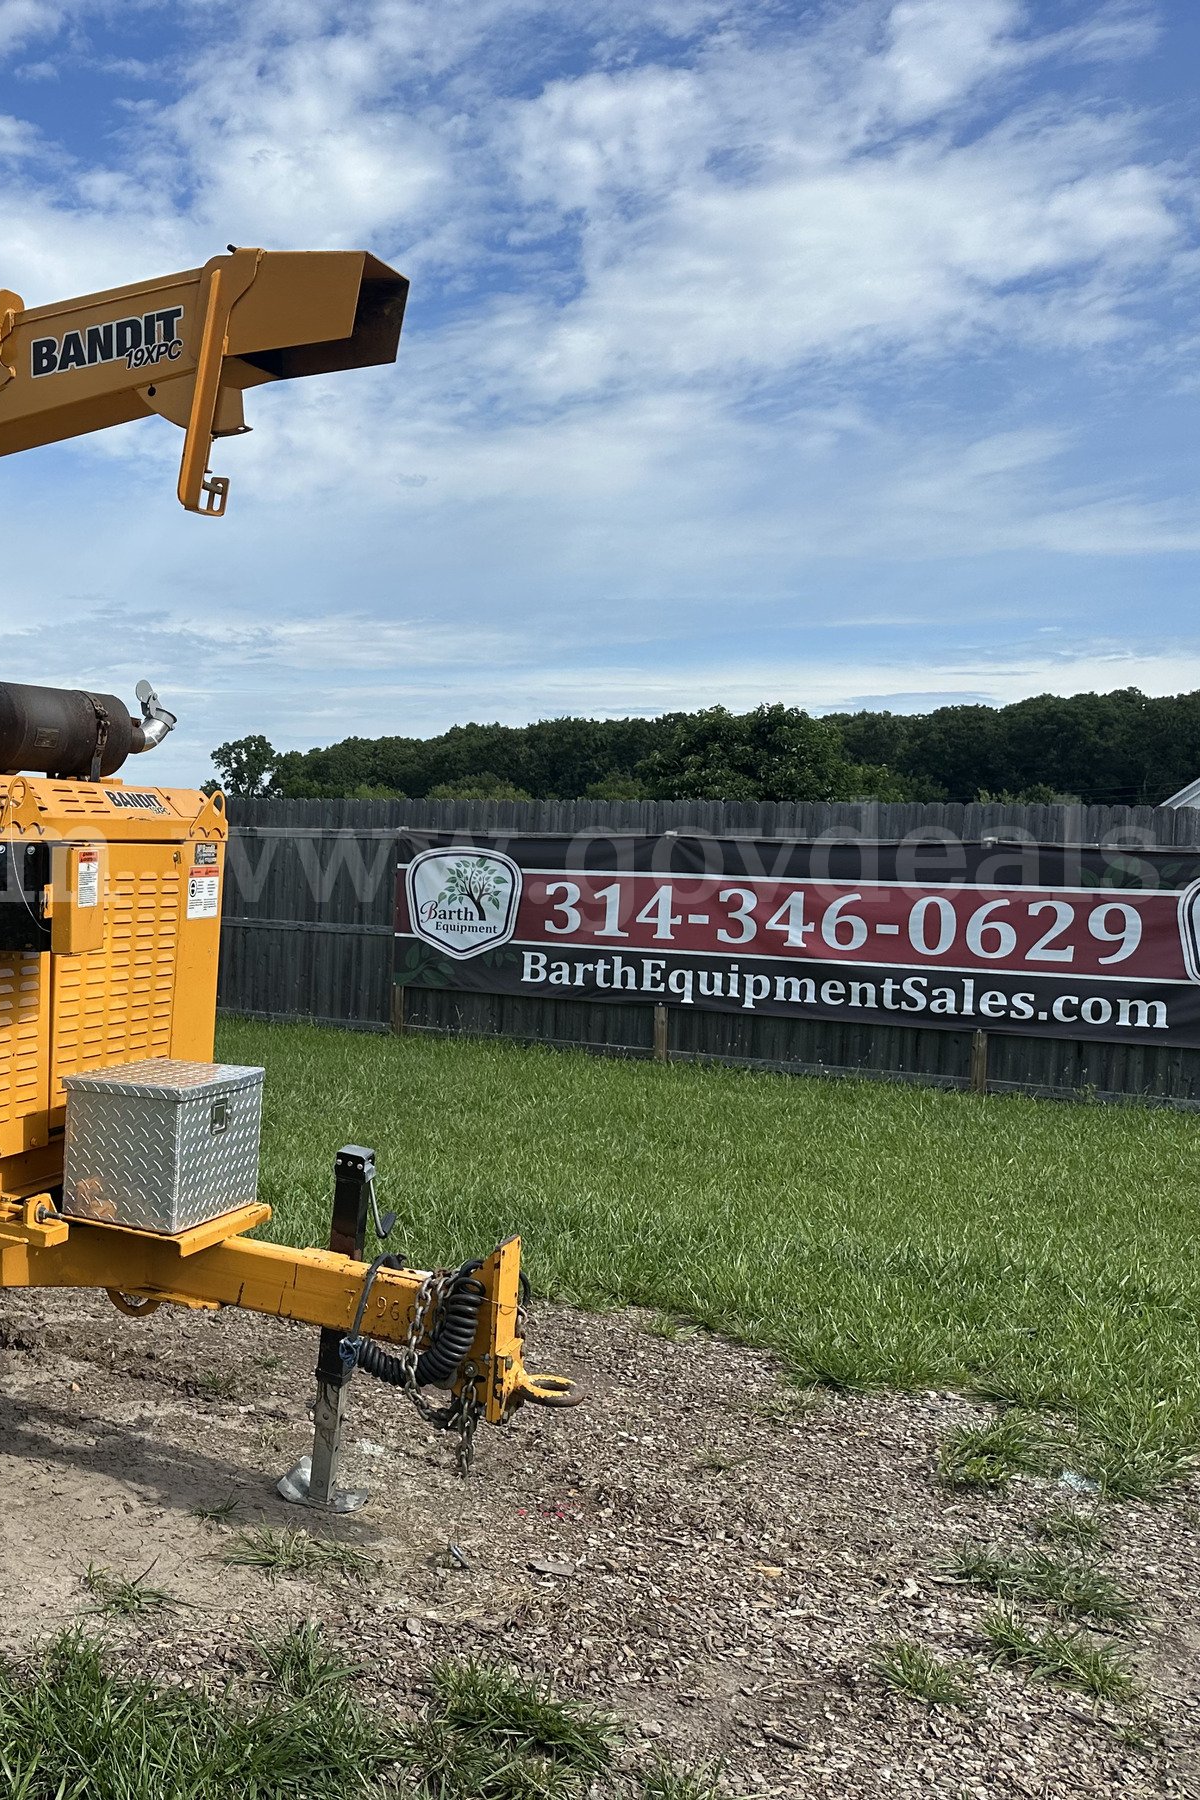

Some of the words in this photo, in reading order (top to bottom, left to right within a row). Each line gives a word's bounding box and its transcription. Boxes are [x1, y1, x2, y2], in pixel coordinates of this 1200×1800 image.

[31, 305, 184, 378] BANDIT
[125, 338, 184, 369] 19XPC
[103, 789, 163, 809] BANDIT
[420, 900, 474, 923] Barth
[544, 881, 1142, 964] 314-346-0629
[435, 921, 498, 934] Equipment
[521, 950, 1169, 1028] BarthEquipmentSales.com
